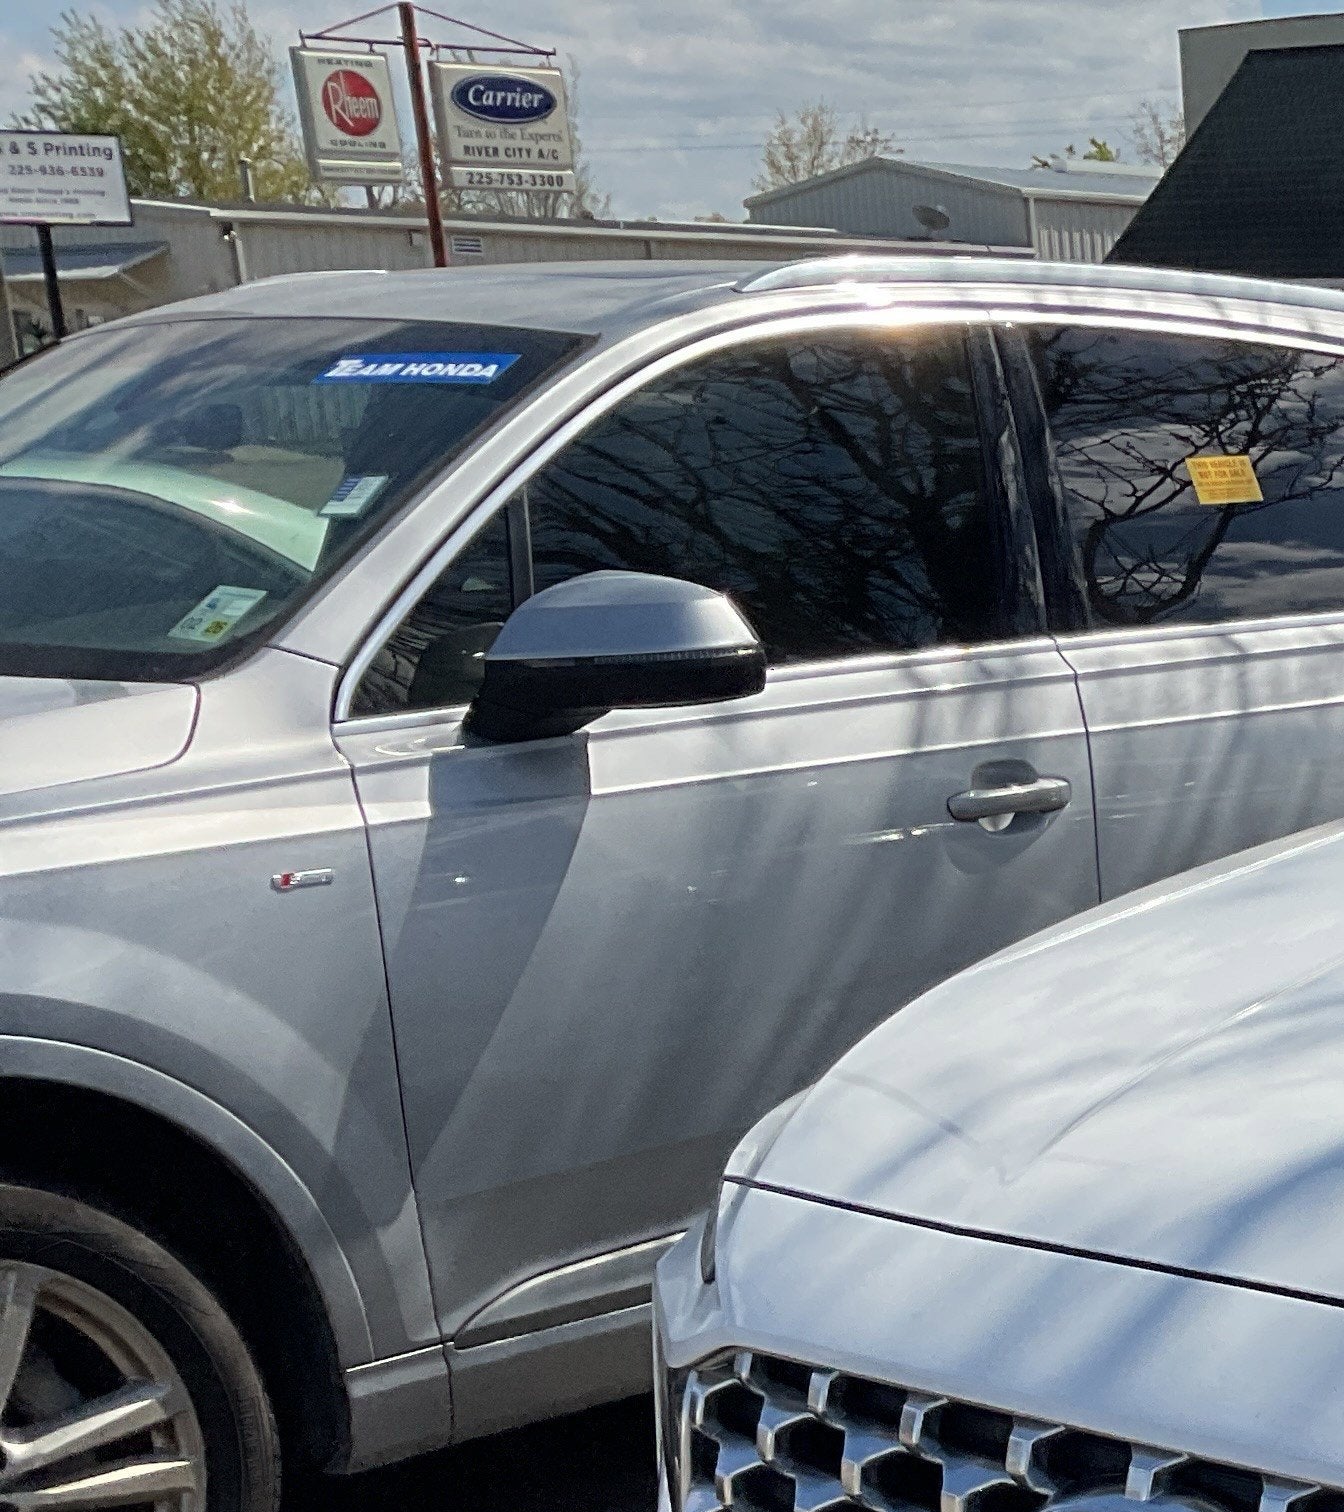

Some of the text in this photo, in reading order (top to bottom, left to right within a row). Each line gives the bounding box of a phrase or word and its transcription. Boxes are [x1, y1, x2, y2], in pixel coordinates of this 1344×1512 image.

[326, 70, 380, 127] Rheem
[467, 84, 544, 108] Carrier
[43, 142, 113, 160] Printing
[463, 144, 559, 161] RIVER CITY A/C
[466, 171, 564, 187] 225-753-3300
[324, 359, 499, 377] TEAM HONDA
